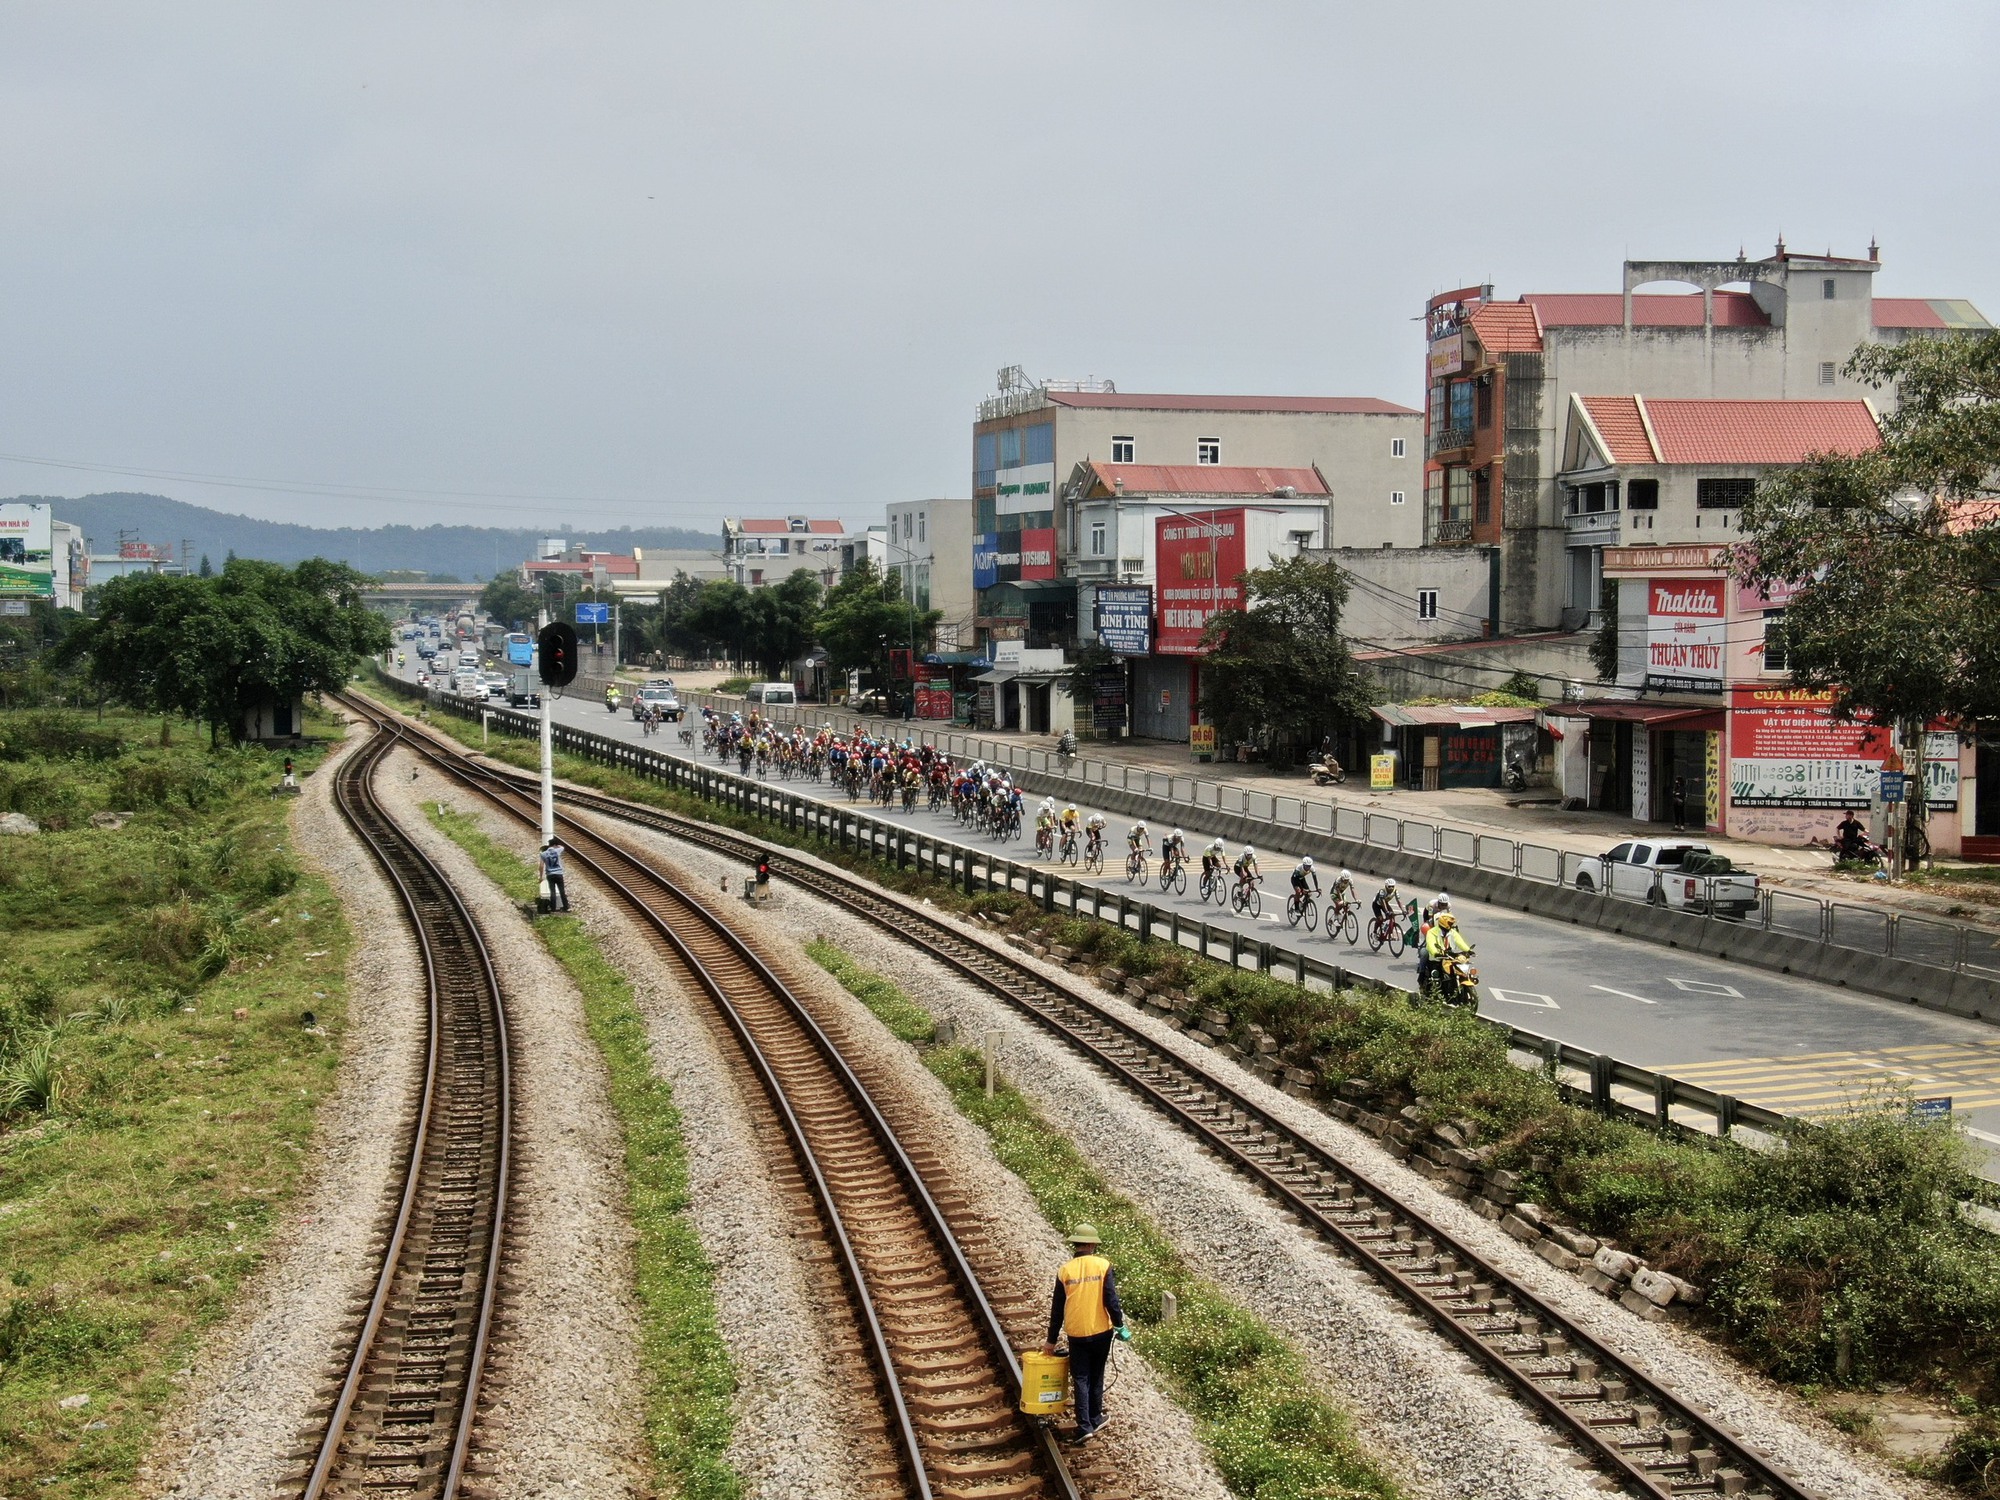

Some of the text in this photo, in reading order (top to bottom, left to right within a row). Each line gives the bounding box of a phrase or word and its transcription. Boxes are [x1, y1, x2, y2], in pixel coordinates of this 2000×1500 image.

[1021, 550, 1051, 566] TOSHIBA
[1654, 588, 1718, 614] Makita
[1100, 610, 1148, 629] BÌNH TÌNH
